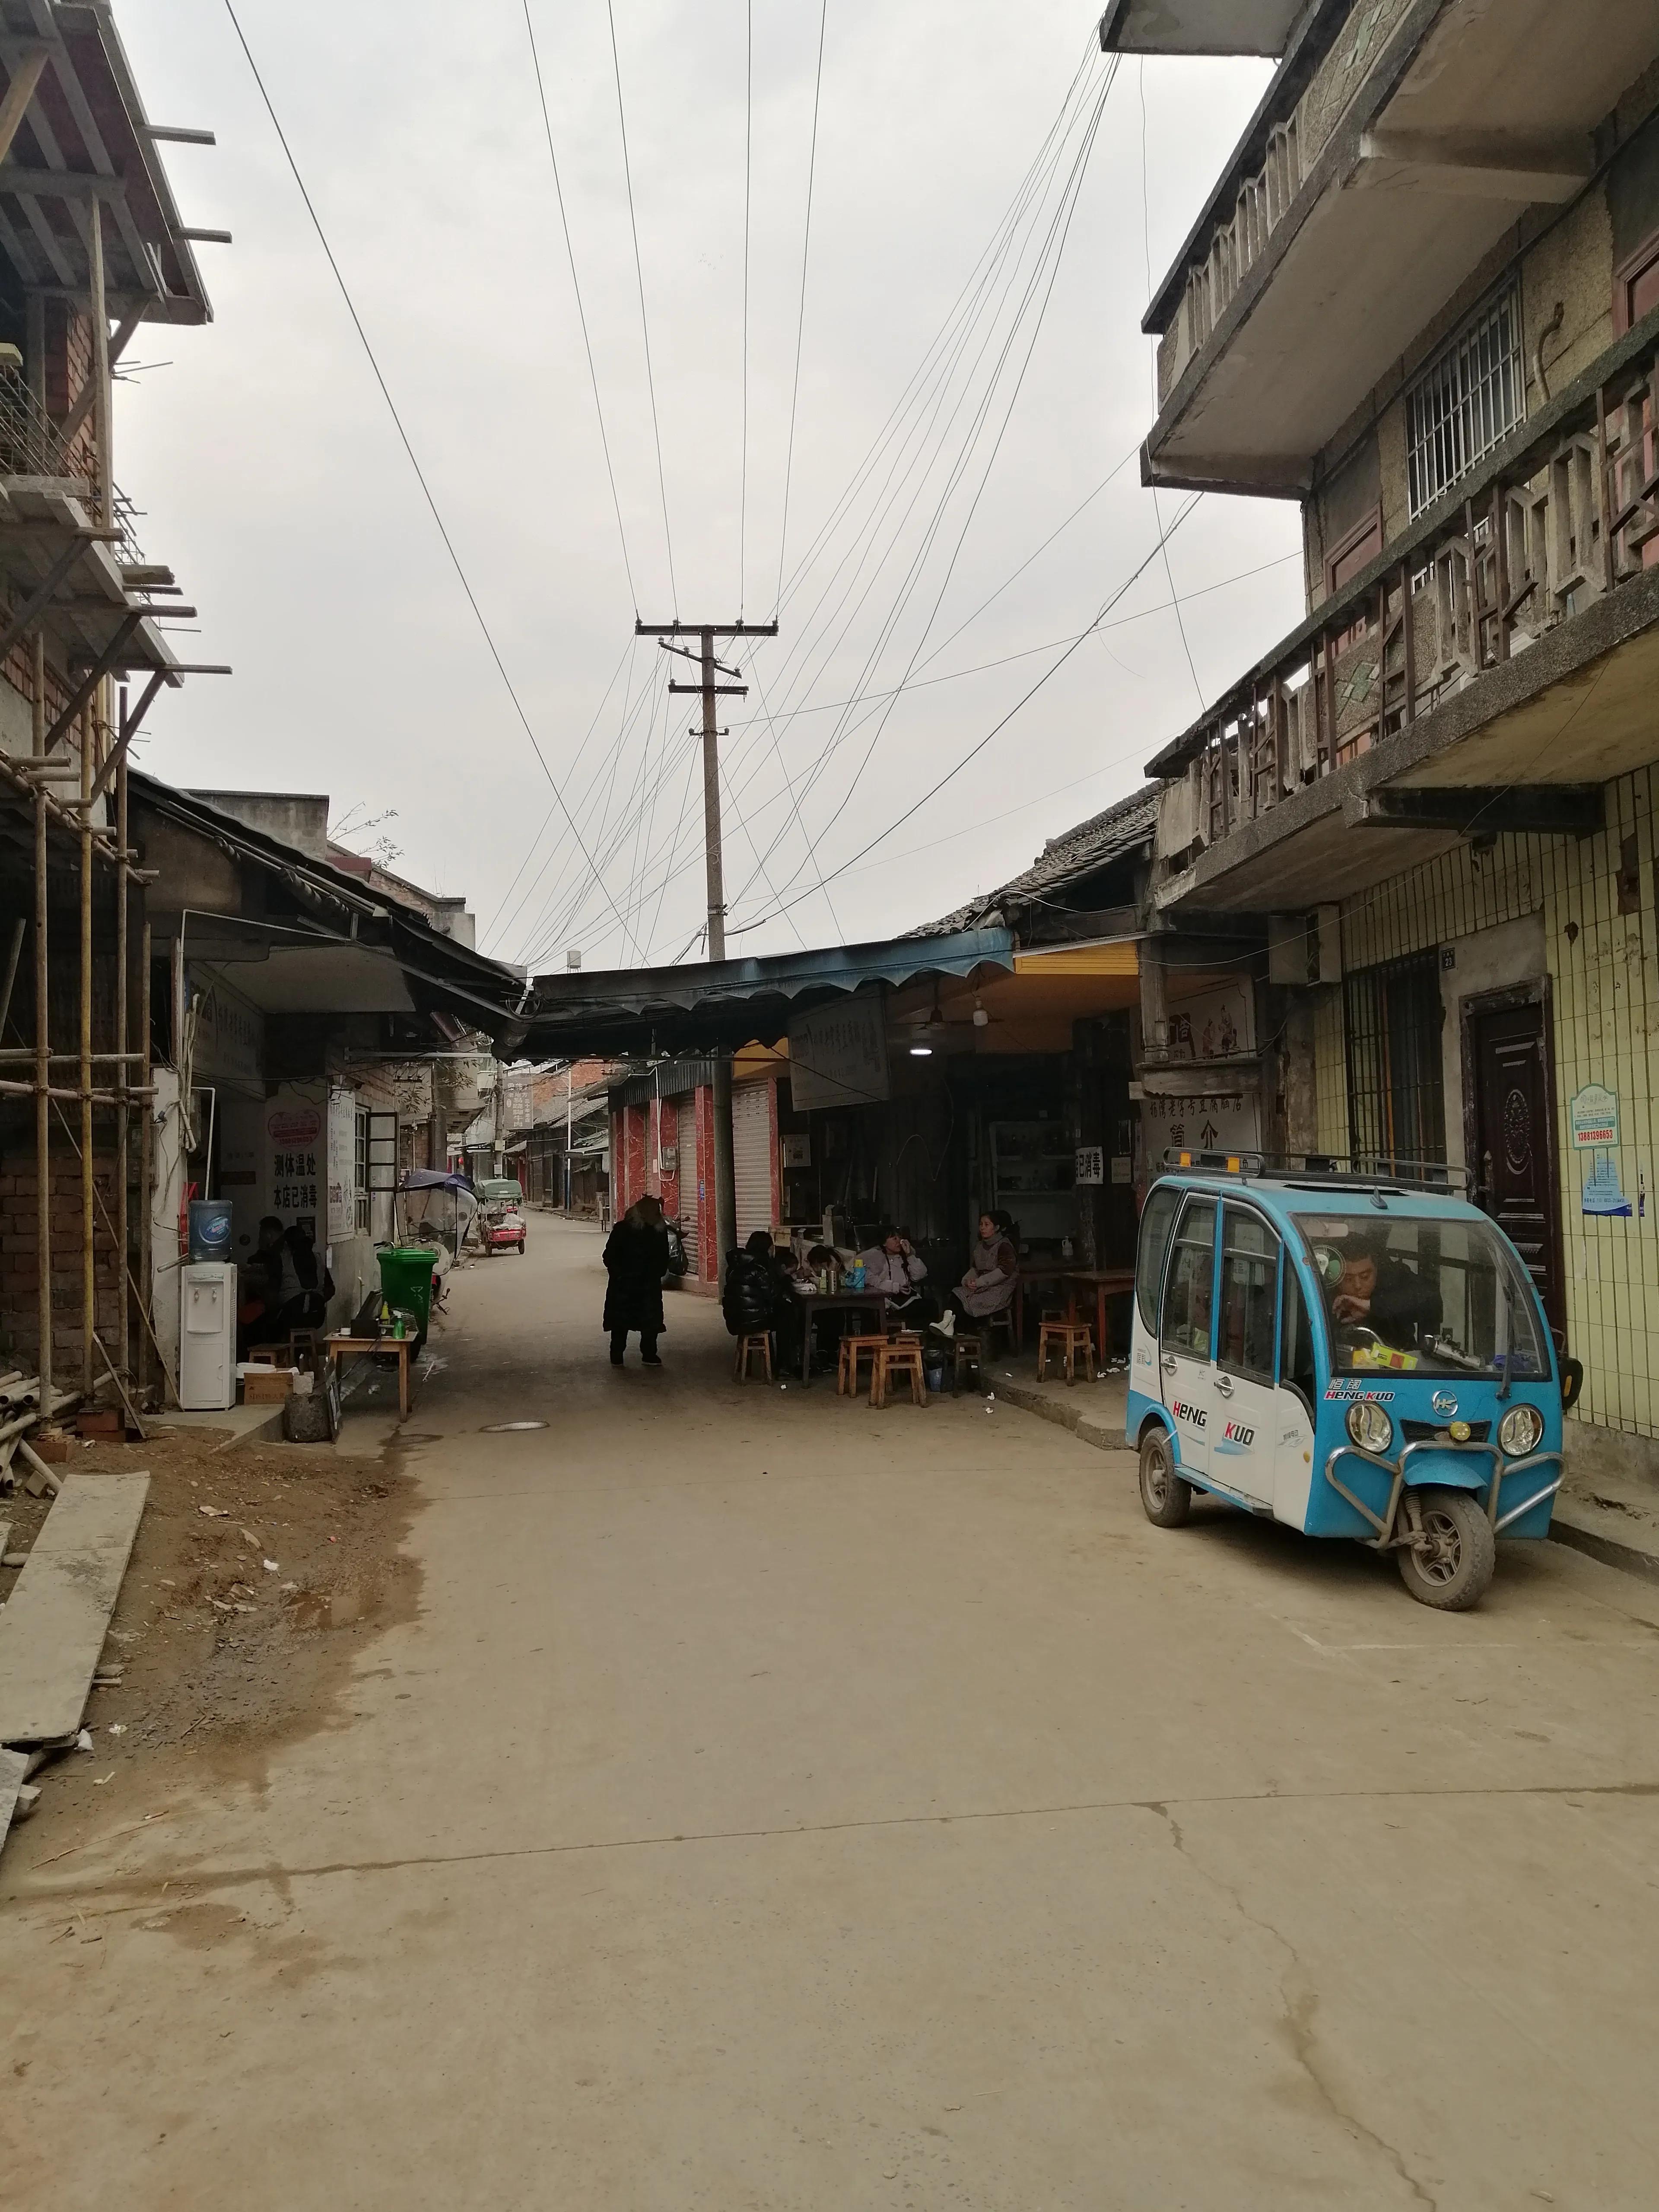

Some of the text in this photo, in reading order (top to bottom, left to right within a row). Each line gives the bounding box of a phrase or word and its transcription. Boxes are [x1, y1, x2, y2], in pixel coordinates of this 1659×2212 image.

[1445, 957, 1452, 966] 23
[1578, 1129, 1613, 1141] 13881396653
[274, 1152, 316, 1177] 测体温处
[1076, 1152, 1100, 1179] 已消毒
[273, 1184, 317, 1209] 本店已消毒
[1328, 1379, 1362, 1390] 恒阔
[1365, 1392, 1395, 1401] KUO
[1224, 1421, 1255, 1446] KUO
